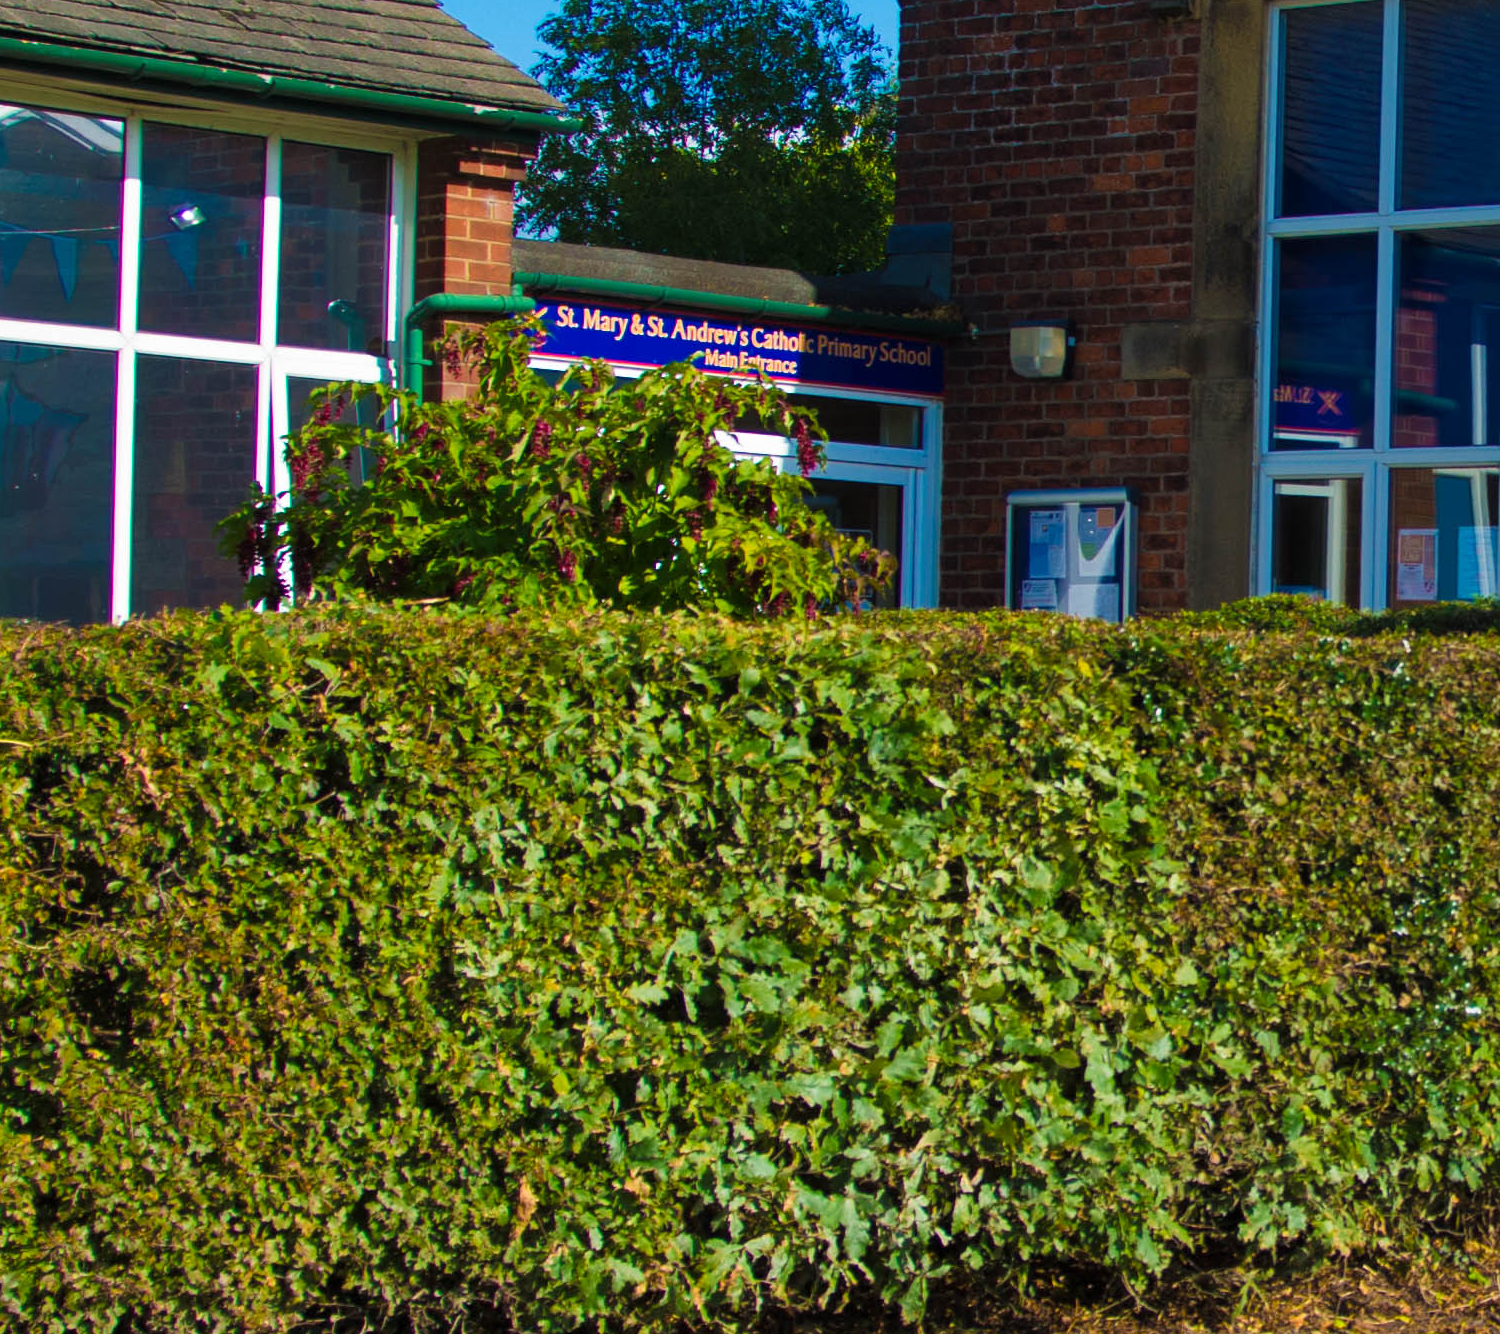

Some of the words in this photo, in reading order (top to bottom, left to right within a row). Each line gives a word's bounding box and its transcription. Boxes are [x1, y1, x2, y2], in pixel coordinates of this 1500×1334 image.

[556, 305, 579, 329] St.
[582, 307, 628, 341] Mary
[631, 313, 645, 336] &
[647, 315, 669, 338] St.
[670, 318, 749, 347] Andrew's
[751, 327, 814, 354] Catholic
[817, 334, 878, 368] Primary
[879, 341, 931, 367] School
[704, 348, 738, 368] Main
[739, 350, 798, 375] Entrance
